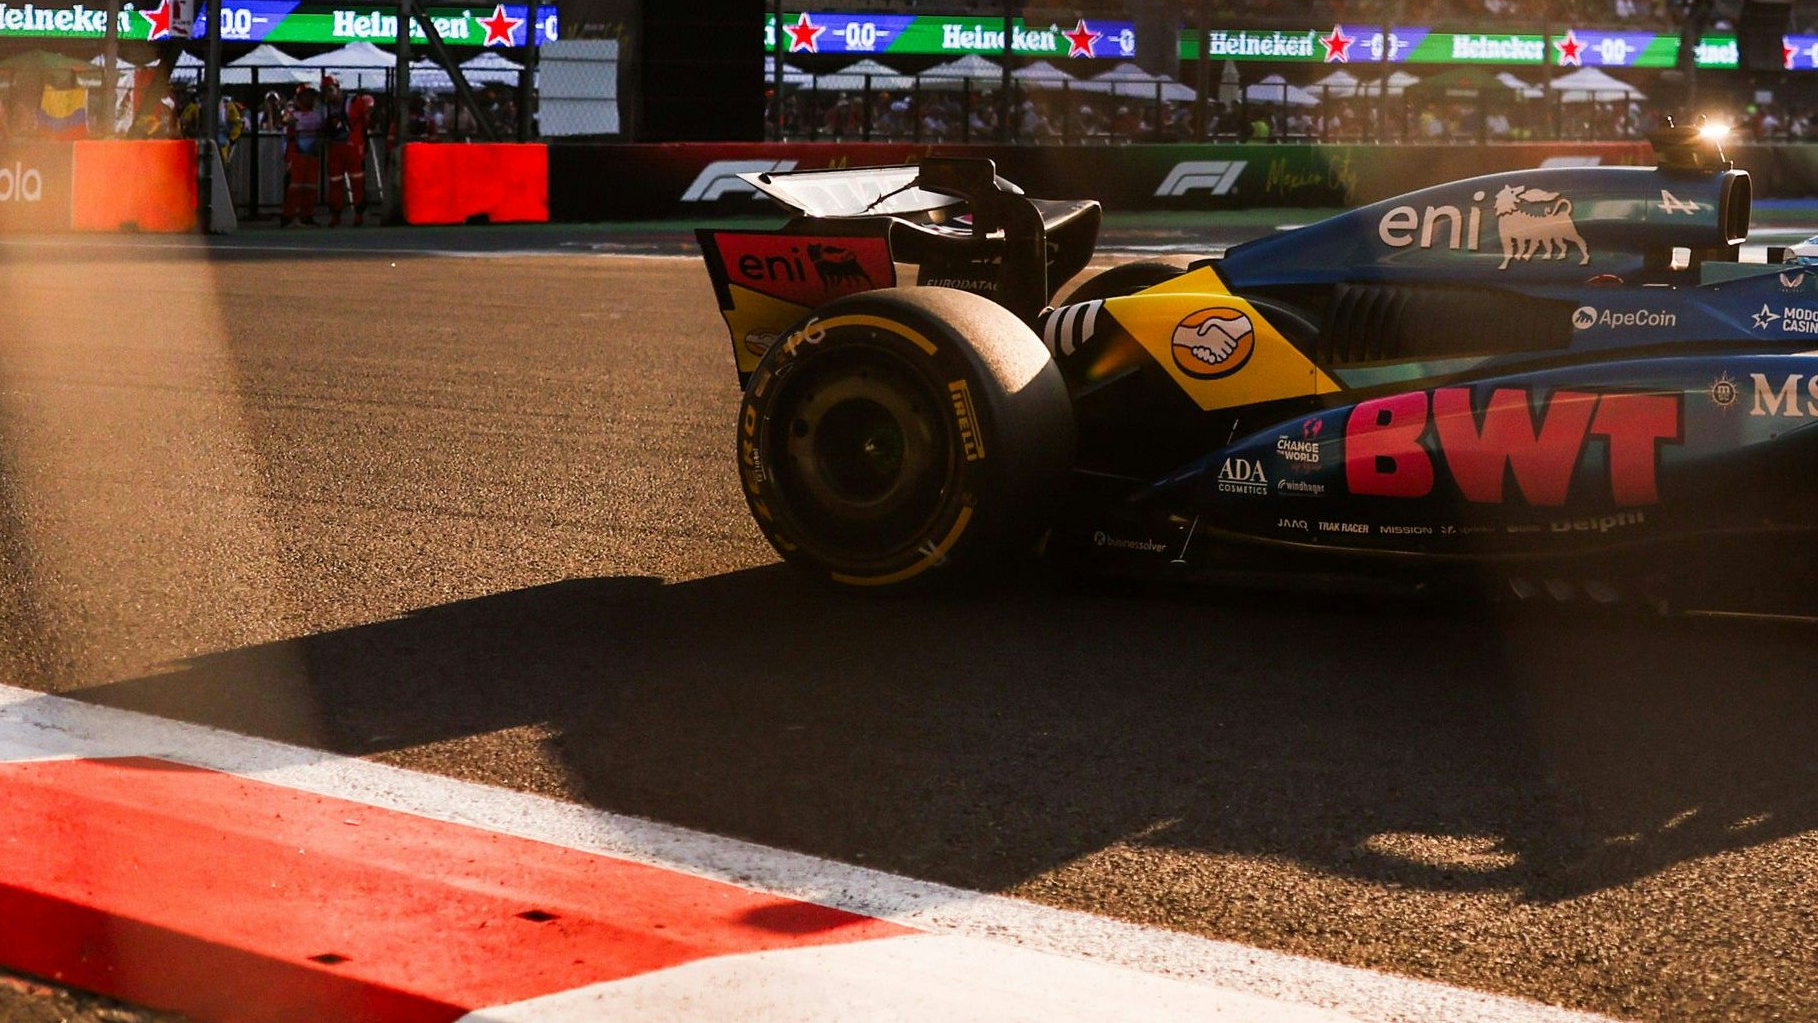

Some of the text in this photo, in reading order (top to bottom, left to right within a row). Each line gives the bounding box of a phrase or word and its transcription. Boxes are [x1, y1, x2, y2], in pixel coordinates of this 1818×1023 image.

[1378, 190, 1486, 250] eni
[739, 248, 802, 281] eni
[1598, 308, 1676, 332] ApeCoin
[948, 379, 986, 462] PIRELLI
[1277, 439, 1319, 453] CHANGE
[1285, 450, 1319, 463] WORLD
[1345, 387, 1685, 507] BWT
[1218, 457, 1268, 482] ADA
[1218, 483, 1268, 496] COSMETICS
[1318, 521, 1369, 534] TRAK RACER
[1380, 525, 1433, 535] MISSION
[1551, 510, 1646, 533] Delphi
